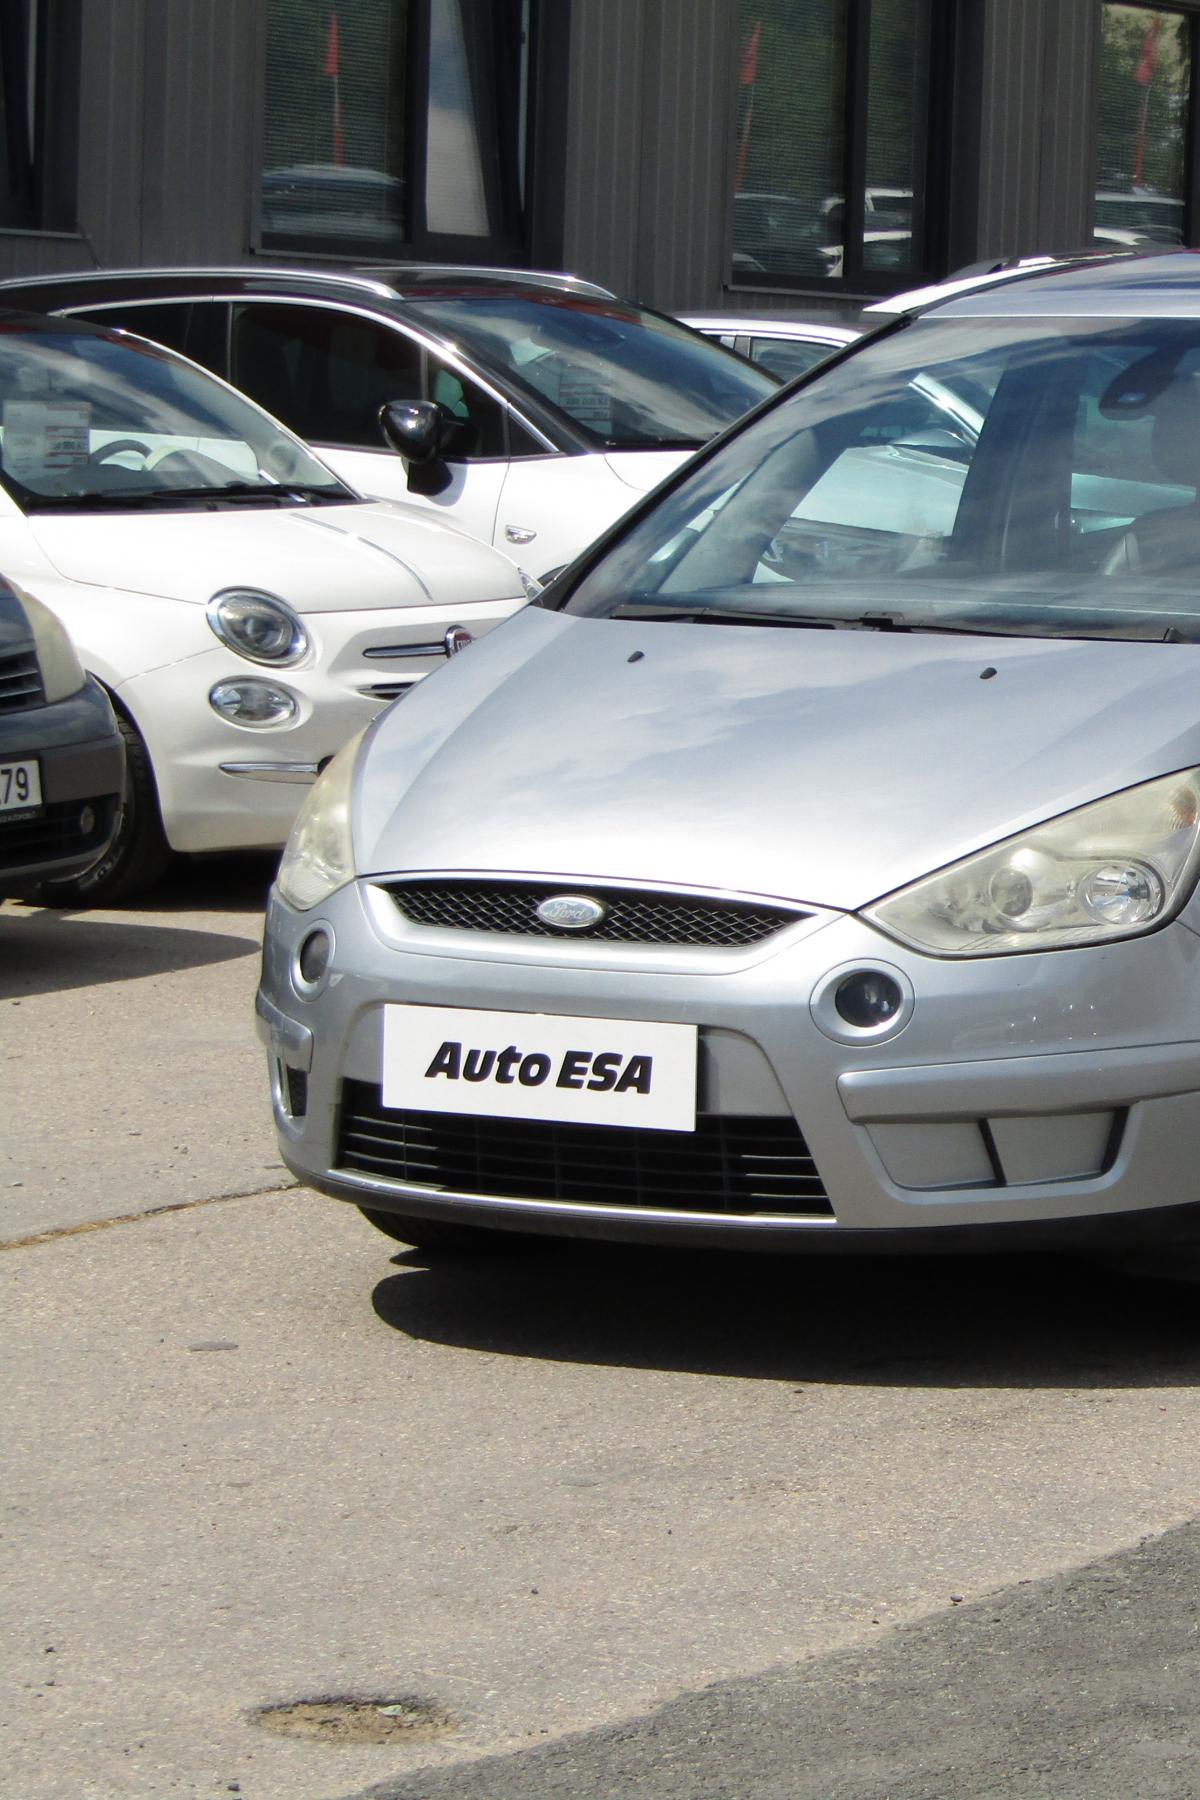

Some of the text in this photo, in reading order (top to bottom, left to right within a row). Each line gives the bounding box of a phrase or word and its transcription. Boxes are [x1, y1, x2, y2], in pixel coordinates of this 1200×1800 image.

[547, 901, 586, 920] Ford
[424, 1041, 653, 1094] Auto ESA
